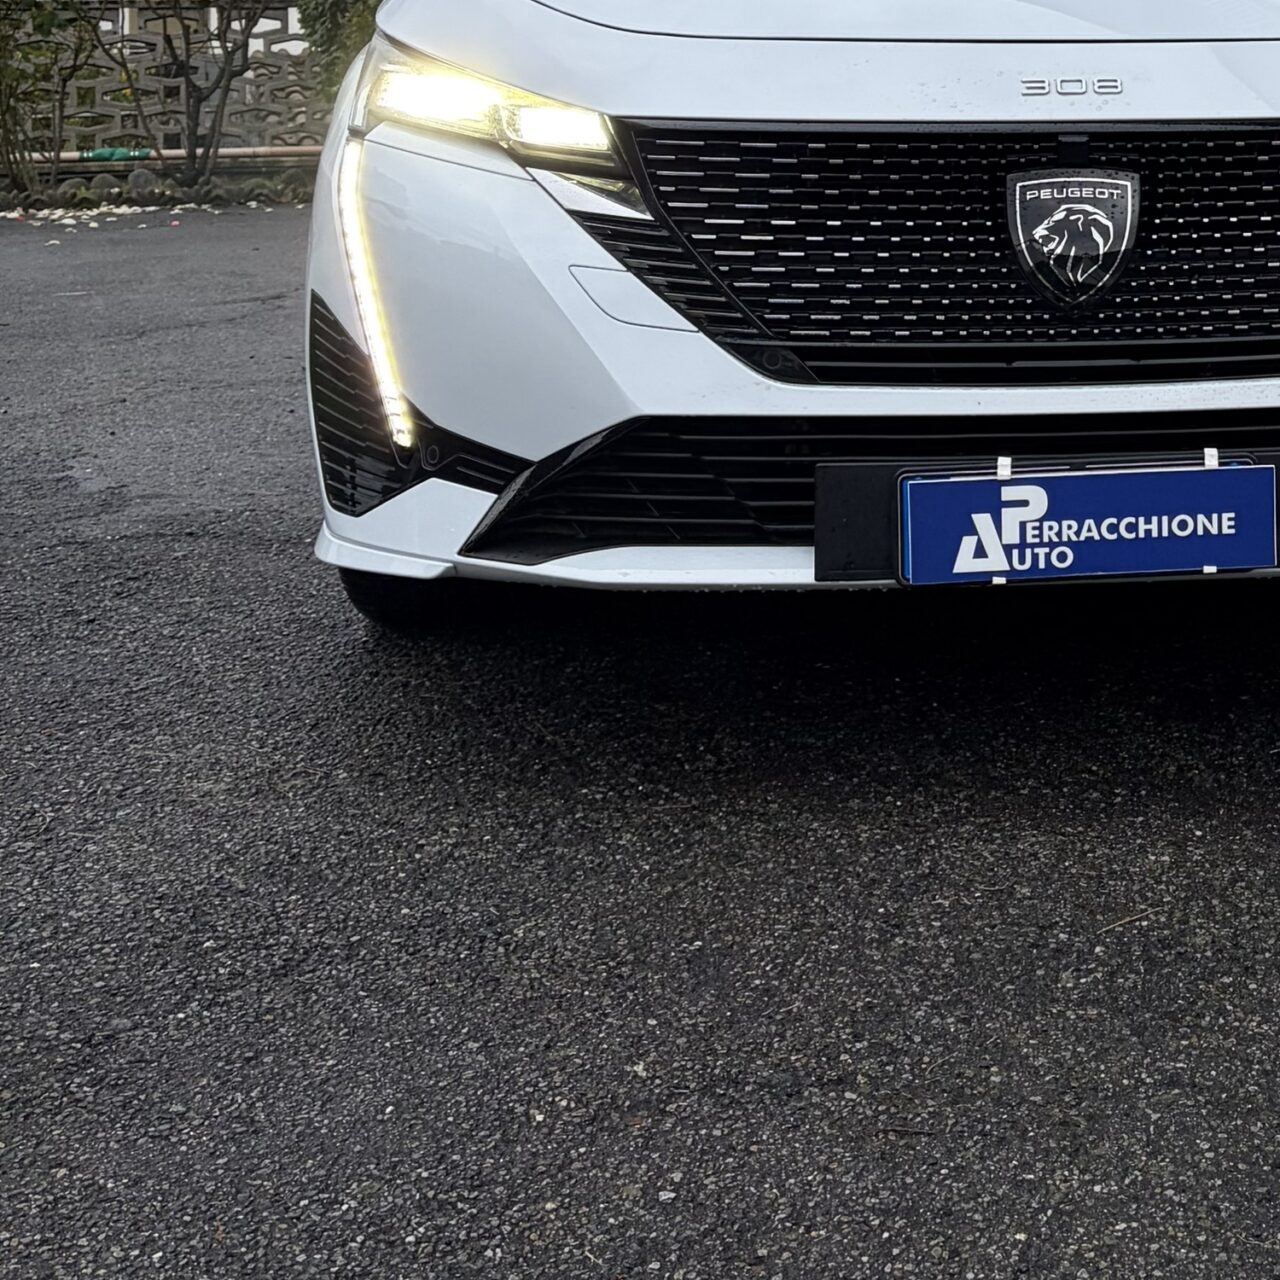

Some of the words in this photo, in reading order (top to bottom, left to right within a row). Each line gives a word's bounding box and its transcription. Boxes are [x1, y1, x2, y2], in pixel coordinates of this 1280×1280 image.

[1020, 76, 1123, 97] 308
[1026, 187, 1122, 201] PEUGEOT
[1000, 484, 1236, 545] PERRACCHIONE
[952, 513, 1074, 574] AUTO
